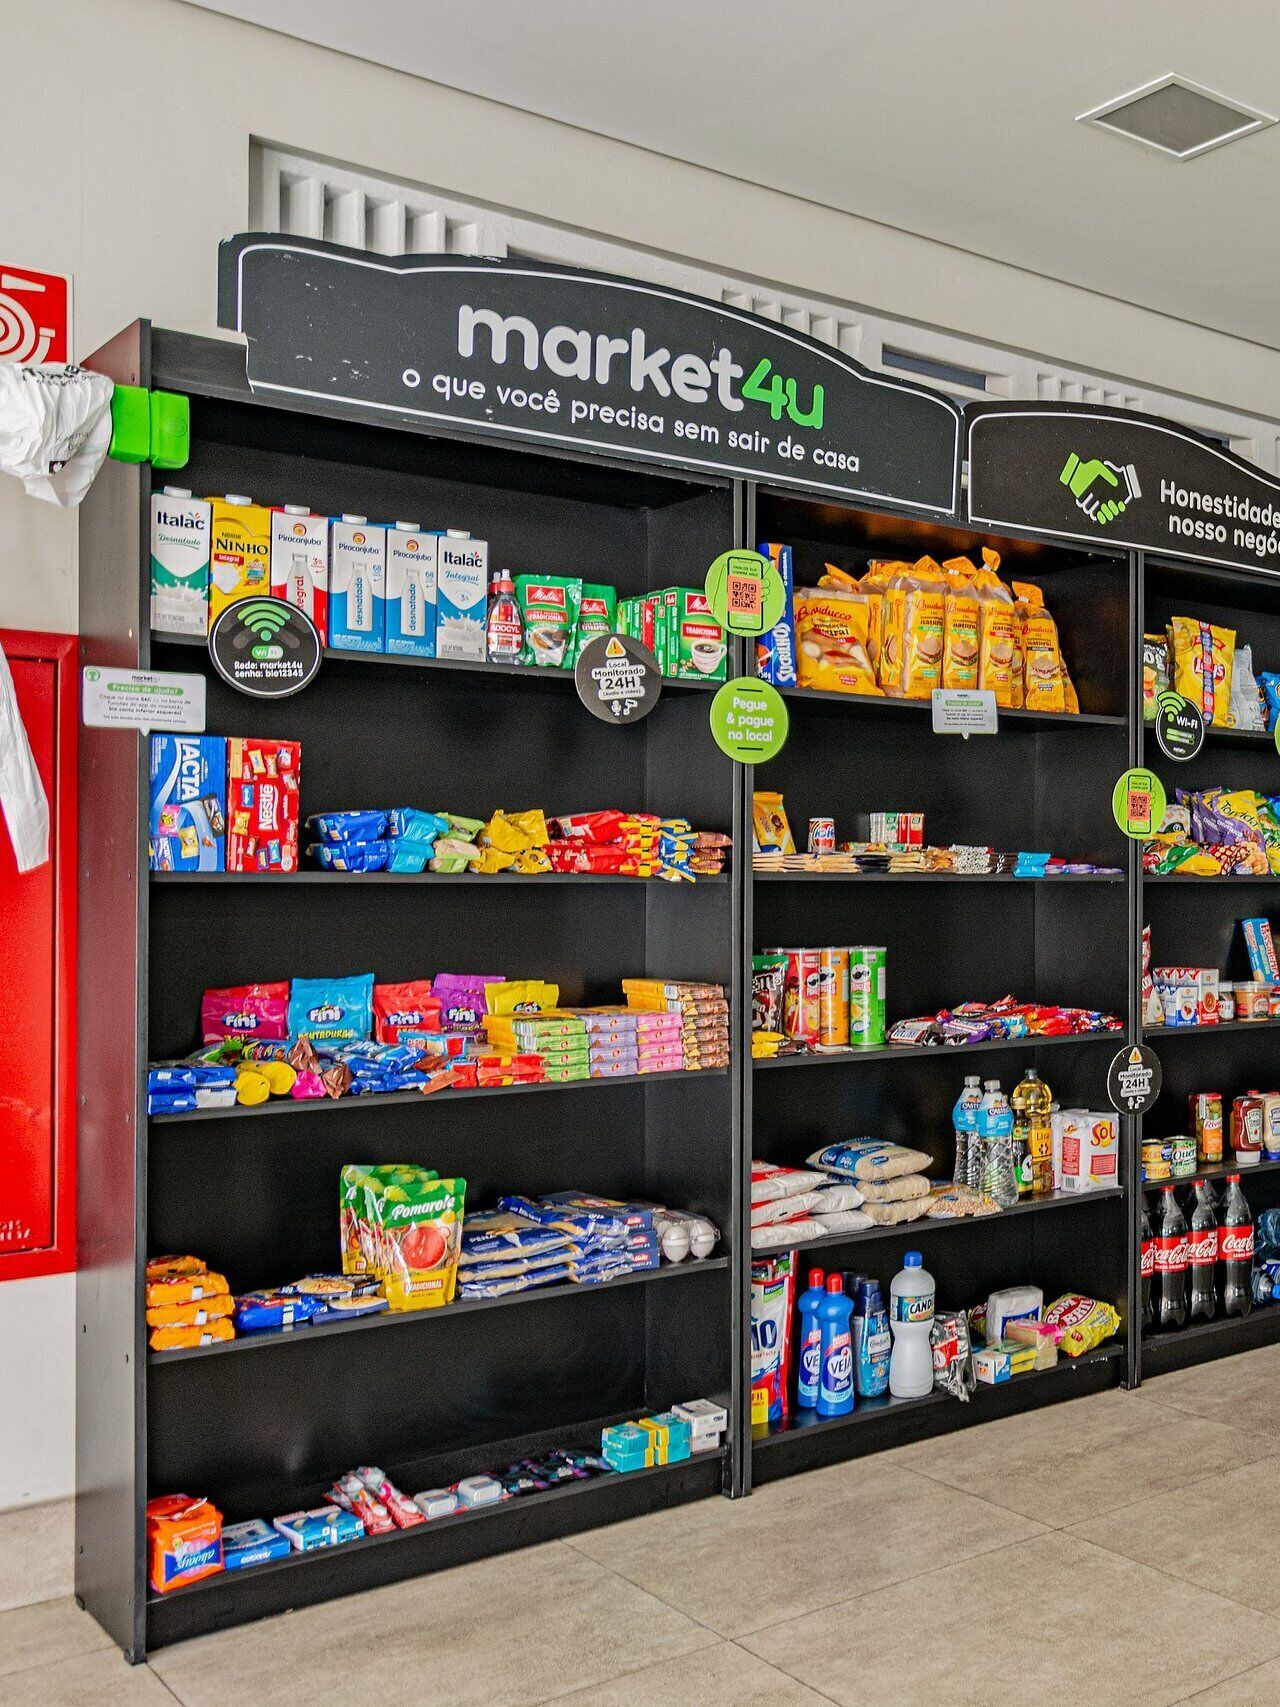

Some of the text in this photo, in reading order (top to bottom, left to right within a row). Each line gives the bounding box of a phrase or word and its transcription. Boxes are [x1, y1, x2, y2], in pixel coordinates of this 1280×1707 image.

[457, 303, 825, 430] market4u
[402, 368, 860, 473] o que você precisa sem sair de casa
[157, 511, 206, 531] Italac
[1168, 513, 1227, 543] nosso
[216, 538, 268, 556] NINHO
[444, 551, 483, 568] Italac
[794, 605, 852, 623] Bauducco
[490, 625, 520, 634] ADOCYL
[685, 627, 719, 637] TRADICIONAL
[594, 667, 644, 678] Monitorado
[605, 678, 636, 690] 24H
[732, 697, 768, 711] Pegue
[726, 714, 774, 731] & pague
[728, 731, 773, 742] no local
[181, 738, 200, 800] LACTA
[226, 1014, 256, 1028] Fini
[310, 1006, 340, 1022] Fini
[389, 1011, 421, 1025] Fini
[449, 1008, 475, 1022] Fini
[1120, 1071, 1151, 1079] Monitorado
[1126, 1079, 1145, 1088] 24H
[391, 1195, 456, 1221] Pomarola
[805, 1355, 819, 1368] VE
[177, 1549, 215, 1571] always
